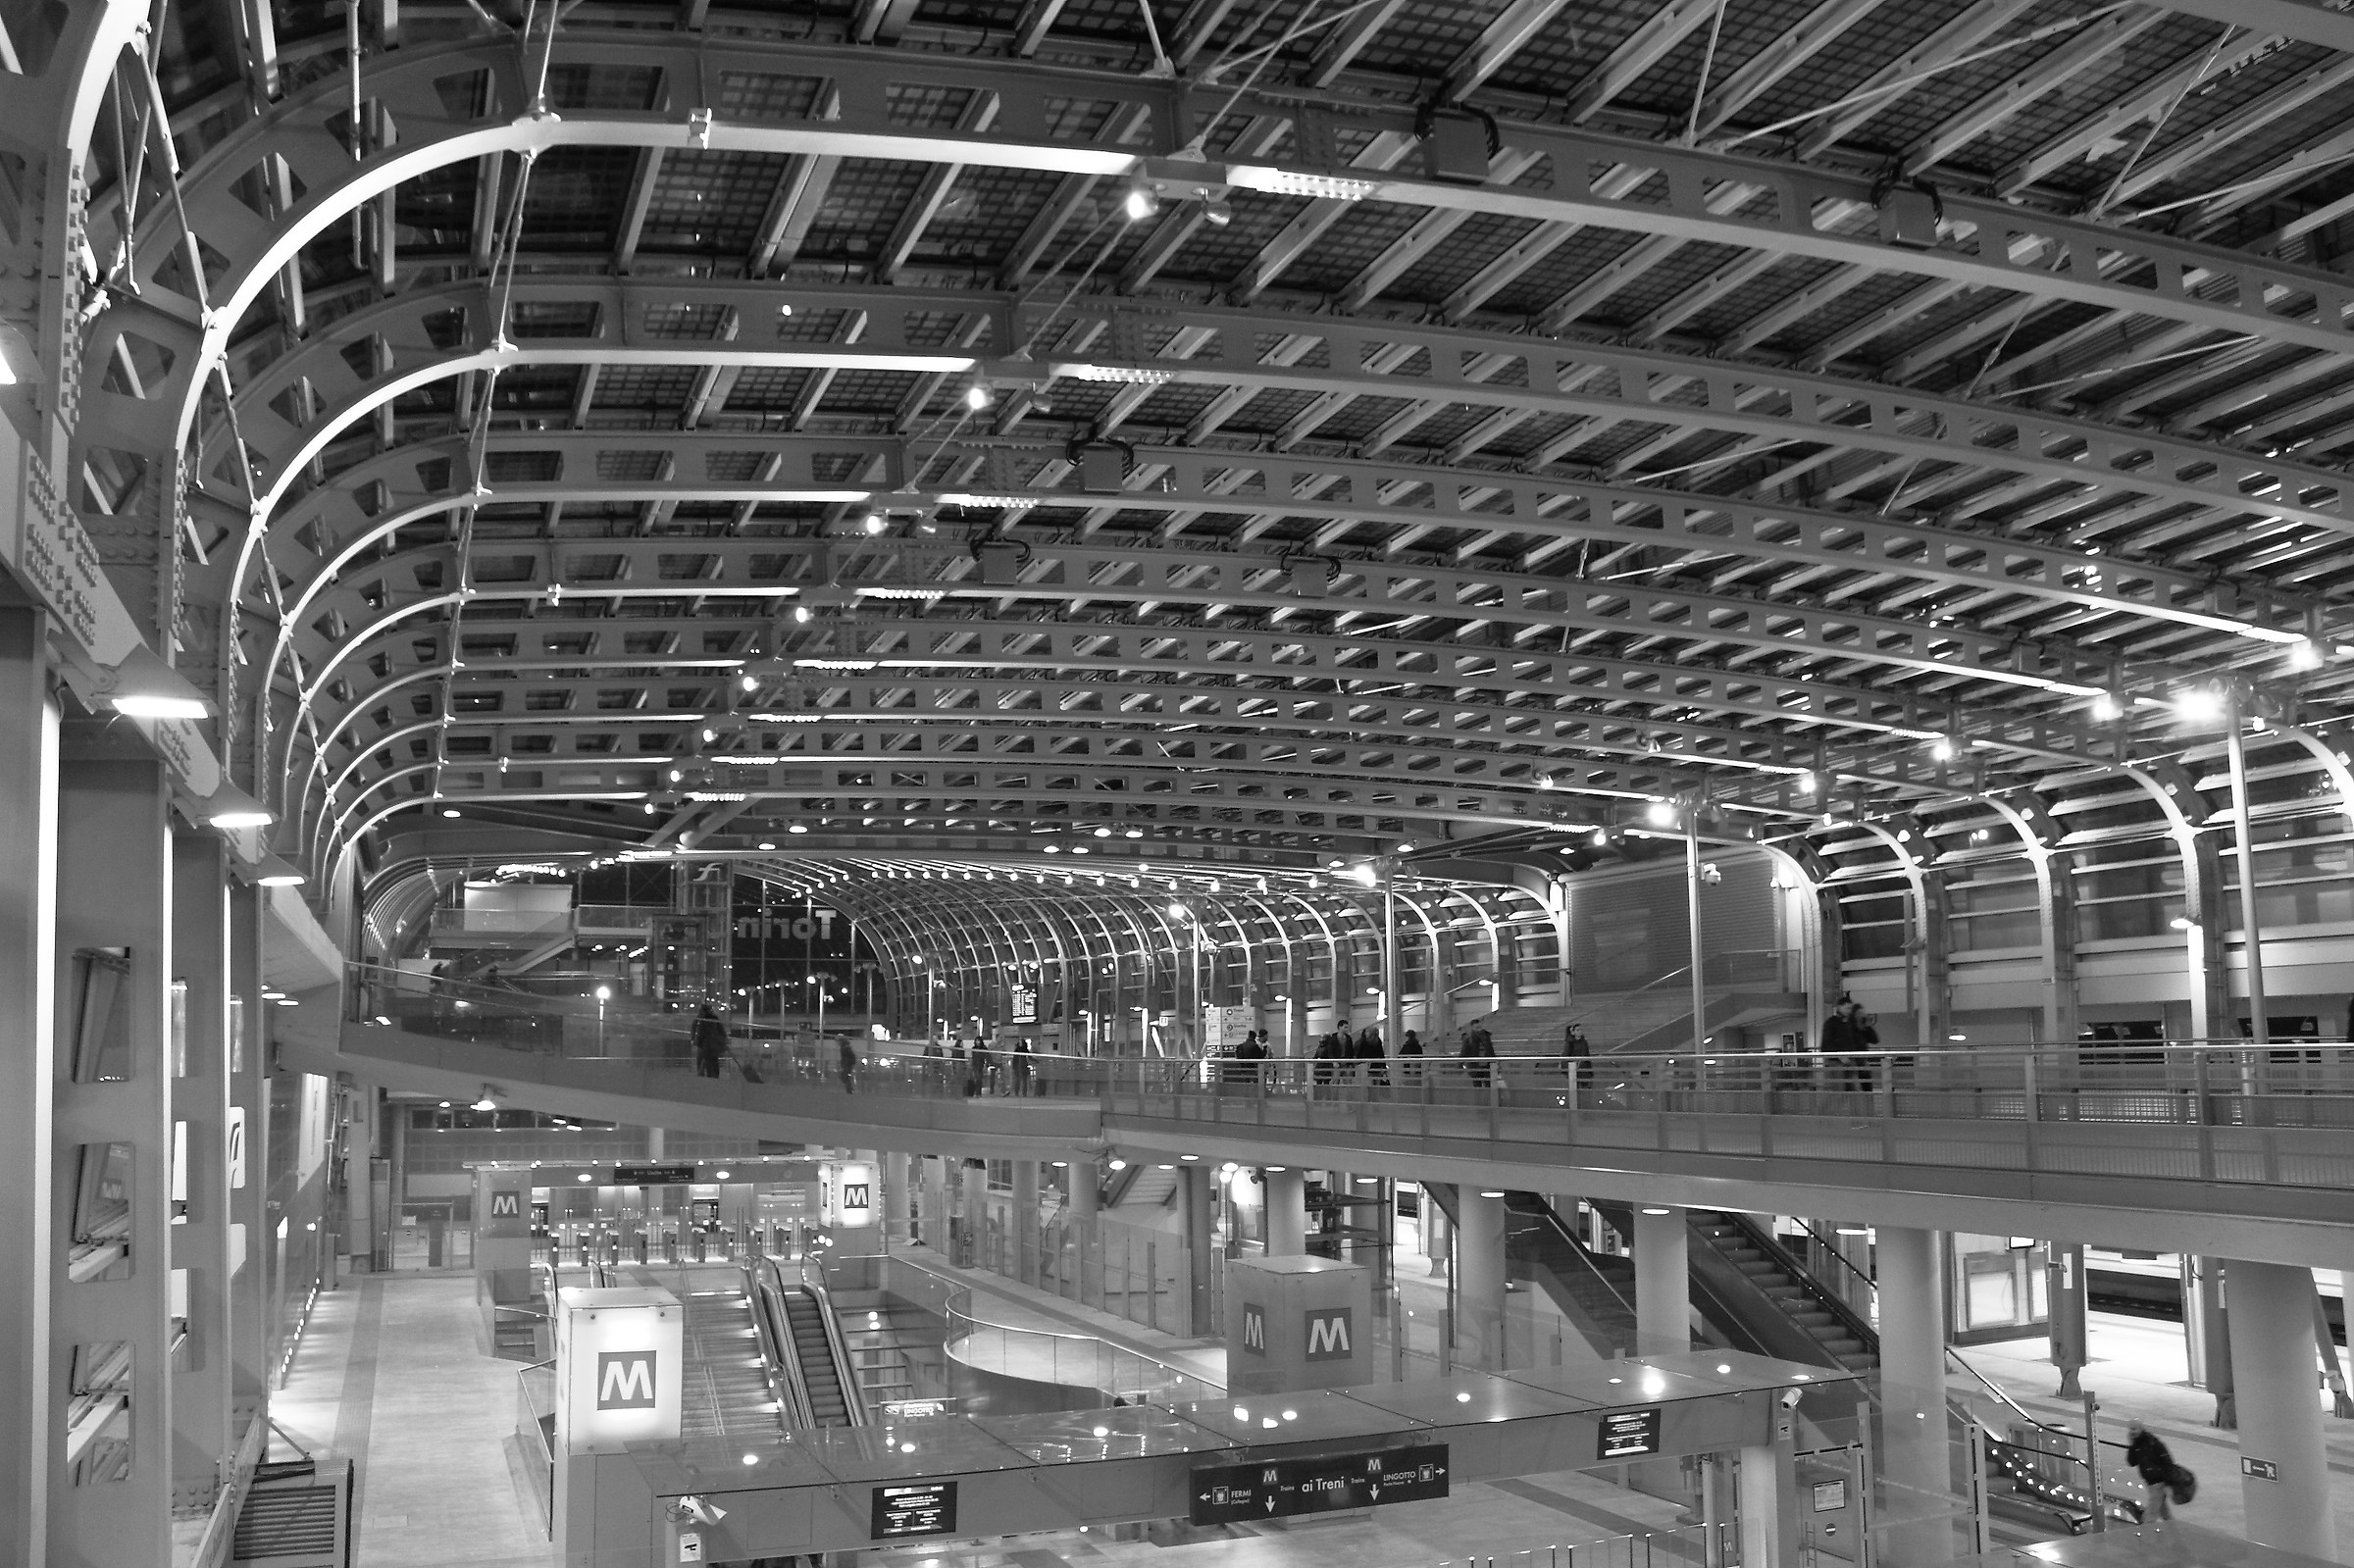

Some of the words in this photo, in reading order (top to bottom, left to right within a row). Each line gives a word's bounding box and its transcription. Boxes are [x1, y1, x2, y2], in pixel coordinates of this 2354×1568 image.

[492, 1195, 518, 1214] M
[844, 1188, 867, 1205] M
[1245, 1312, 1263, 1349] M
[1308, 1317, 1350, 1353] M
[600, 1360, 653, 1400] M
[1367, 1458, 1381, 1471] M
[1262, 1469, 1277, 1483] M
[1302, 1479, 1313, 1492] ai
[1315, 1476, 1345, 1491] Treni
[1383, 1471, 1416, 1482] LINGOTTO
[1231, 1489, 1252, 1498] FERMI
